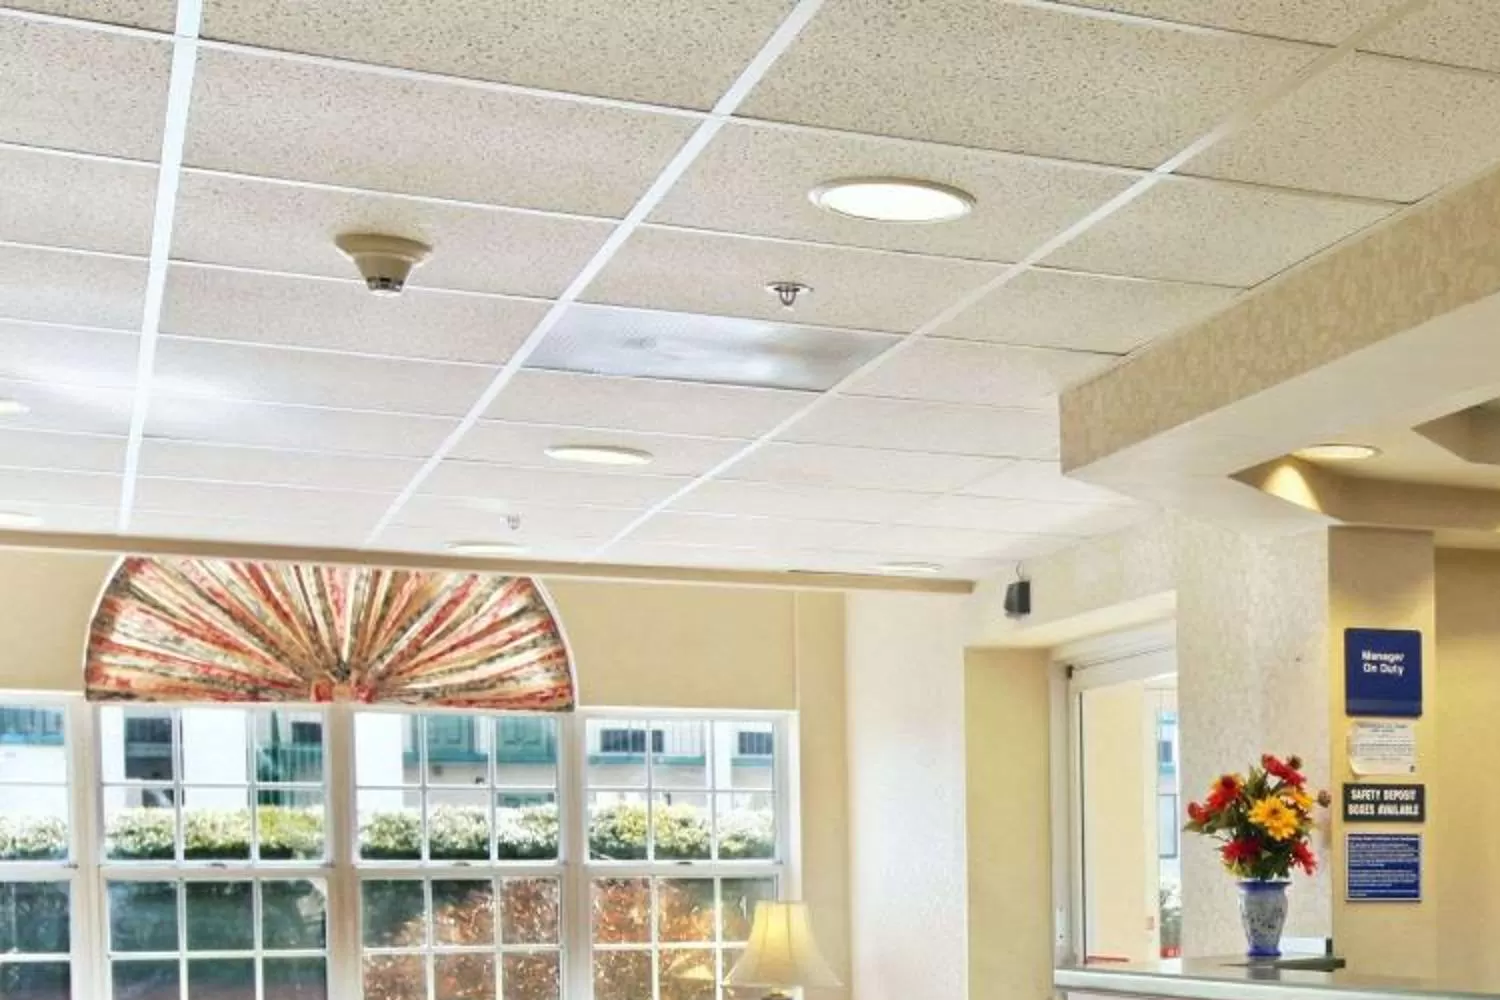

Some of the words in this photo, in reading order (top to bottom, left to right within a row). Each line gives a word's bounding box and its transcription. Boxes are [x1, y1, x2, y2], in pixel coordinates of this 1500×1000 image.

[1361, 649, 1405, 663] Manager
[1363, 663, 1378, 673] On
[1379, 663, 1405, 677] Duty
[1351, 788, 1381, 800] SAFETY
[1383, 788, 1417, 801] DEPOSIT
[1377, 803, 1420, 816] AVAILABLE
